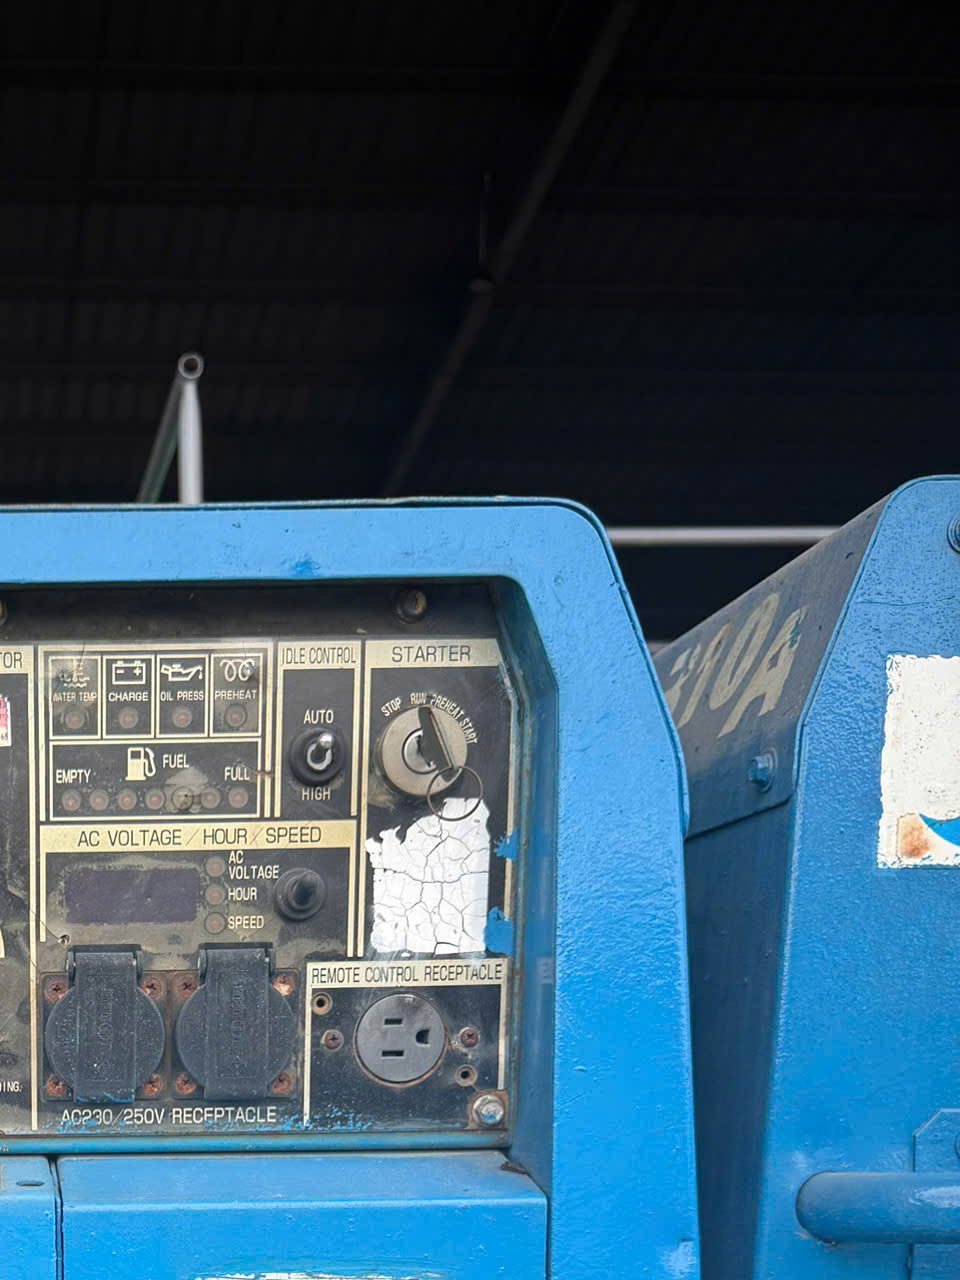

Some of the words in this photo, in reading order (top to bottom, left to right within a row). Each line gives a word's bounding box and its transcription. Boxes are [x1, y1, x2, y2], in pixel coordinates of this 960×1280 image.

[281, 647, 306, 665] IDLE
[308, 646, 357, 665] CONTROL
[392, 644, 471, 663] STARTER
[79, 692, 97, 702] TEMP
[108, 692, 149, 702] CHARGE
[160, 692, 173, 701] OIL
[177, 692, 204, 701] PRESS
[214, 690, 257, 700] PREHEAT
[409, 692, 427, 705] RUN
[381, 697, 402, 717] STOP
[429, 694, 464, 720] PREHEAT
[303, 710, 334, 724] AUTO
[459, 717, 478, 745] START
[162, 754, 189, 768] FUEL
[55, 769, 91, 784] EMPTY
[224, 767, 250, 781] FULL
[301, 787, 331, 801] HIGH
[78, 830, 100, 847] AC
[228, 850, 244, 864] AC
[228, 865, 279, 880] VOLTAGE
[228, 887, 257, 901] HOUR
[227, 916, 265, 930] SPEED
[311, 967, 361, 984] REMOTE
[365, 966, 419, 983] CONTROL
[424, 963, 503, 982] RECEPTACLE
[61, 1107, 166, 1125] AC230/250V
[172, 1106, 277, 1124] RECEPTACLE
